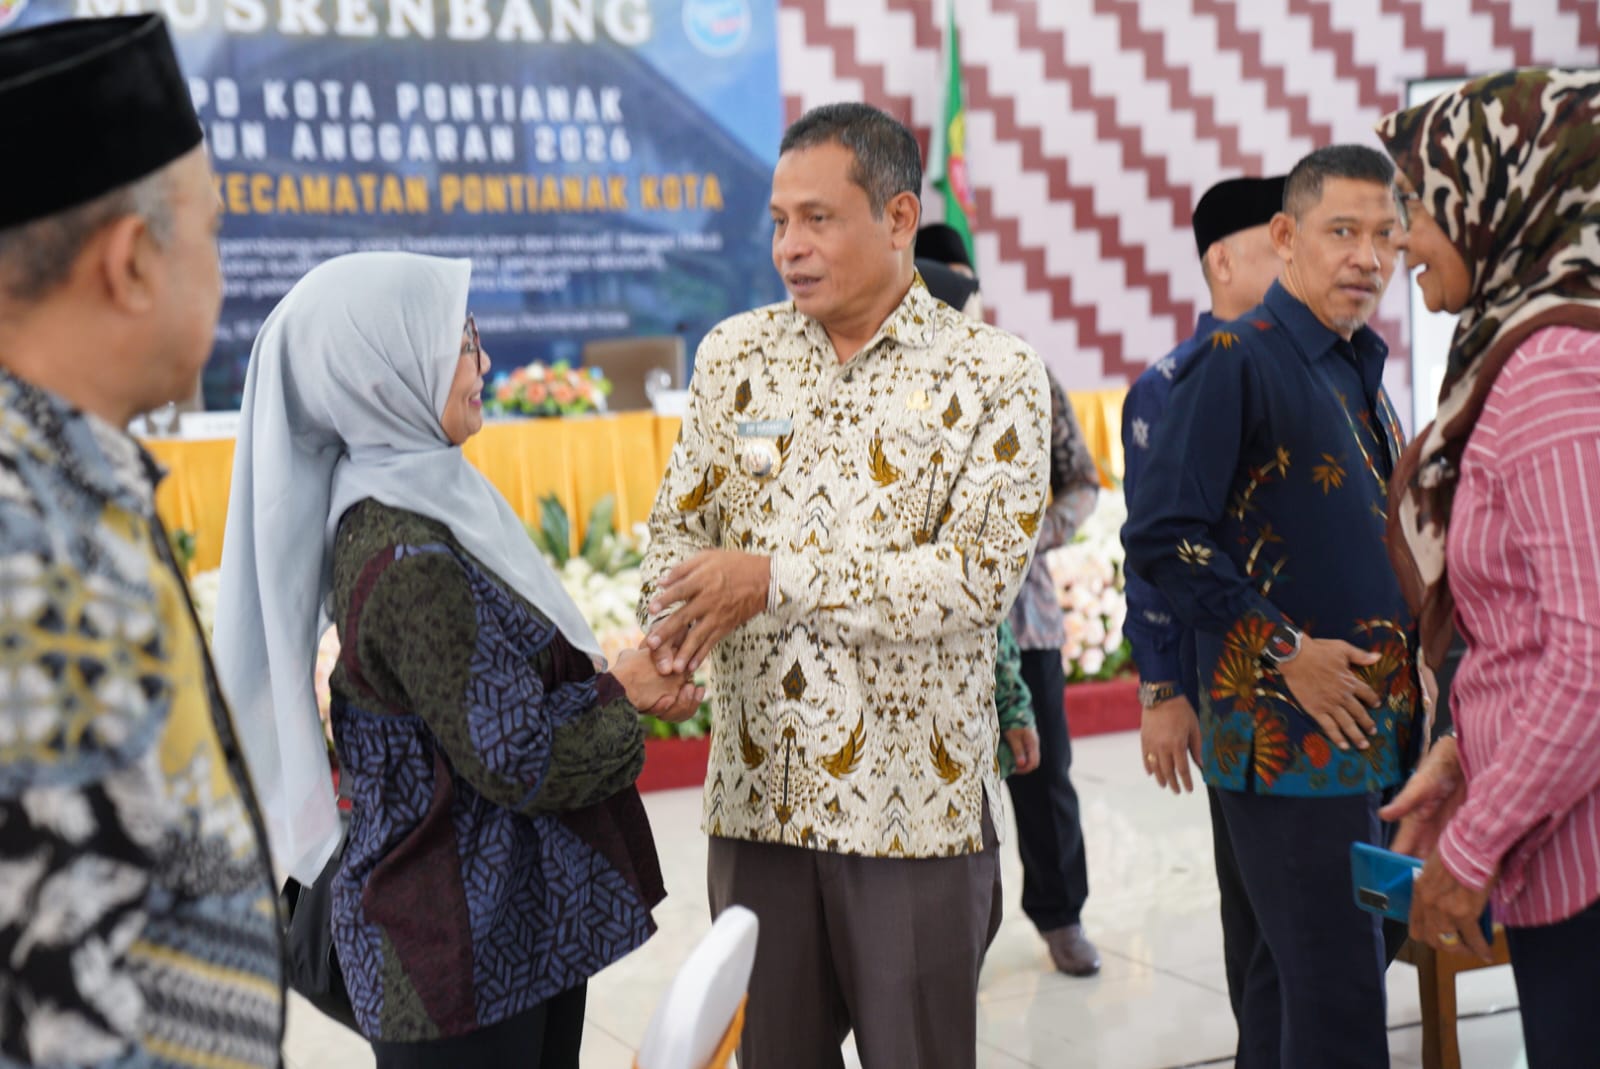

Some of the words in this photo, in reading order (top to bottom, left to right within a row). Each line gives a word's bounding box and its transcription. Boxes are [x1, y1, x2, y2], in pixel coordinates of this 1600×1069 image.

[75, 0, 652, 47] USRENBANG
[188, 77, 240, 118] PD
[263, 79, 376, 120] KOTA
[397, 82, 624, 123] PONTIANAK
[211, 121, 267, 161] UN
[292, 122, 515, 163] ANGGARAN
[534, 124, 632, 163] 2026
[440, 173, 628, 214] PONTIANAK
[640, 172, 724, 212] KOTA
